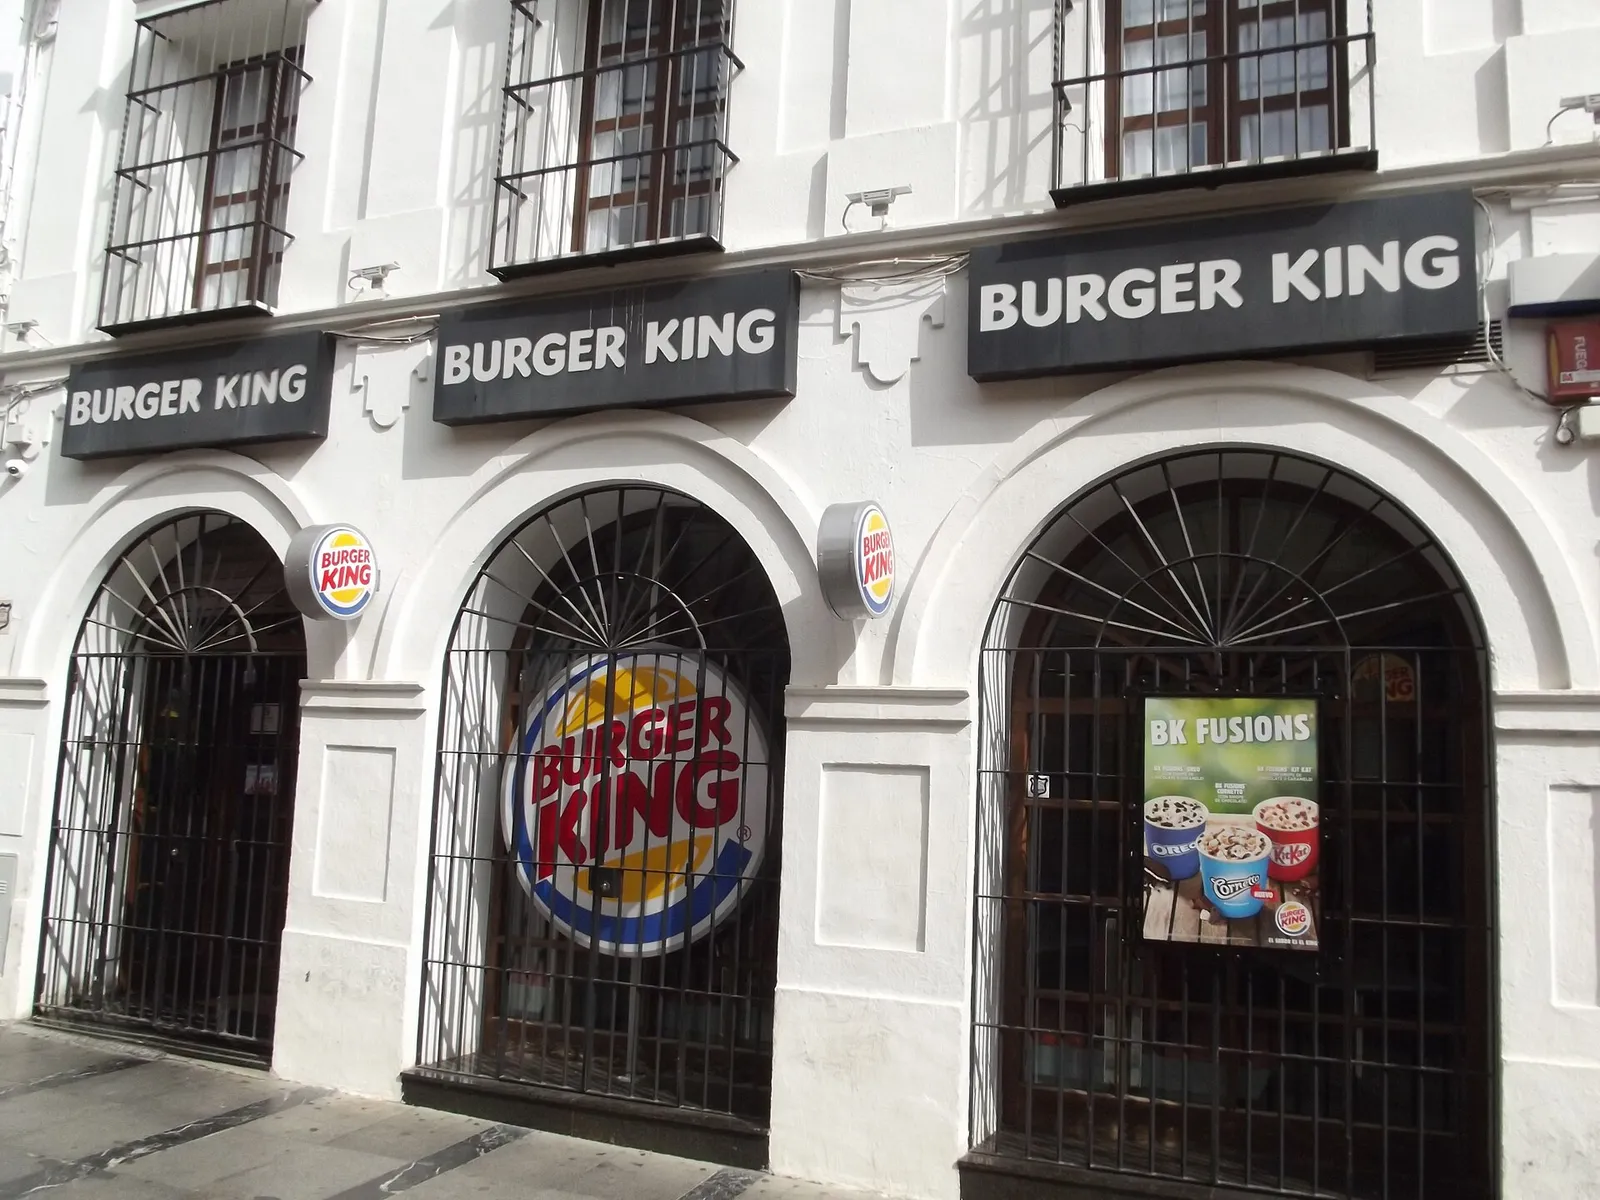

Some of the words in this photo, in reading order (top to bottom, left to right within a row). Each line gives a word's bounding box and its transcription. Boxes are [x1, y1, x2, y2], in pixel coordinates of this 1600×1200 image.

[979, 258, 1244, 332] BURGER
[1271, 235, 1461, 304] KING
[442, 325, 626, 386] BURGER
[644, 308, 776, 364] KING
[1574, 336, 1588, 370] FUEG
[69, 377, 202, 426] BURGER
[214, 364, 307, 410] KING
[321, 549, 370, 568] BURGER
[863, 550, 893, 585] KING
[321, 564, 371, 591] KING
[1150, 719, 1187, 745] BK
[1196, 713, 1310, 744] FUSIONS
[532, 696, 732, 804] BURGER
[538, 750, 740, 881] KING
[1210, 875, 1260, 899] Cornetto
[1280, 909, 1305, 919] BURGER
[1281, 915, 1306, 927] KING
